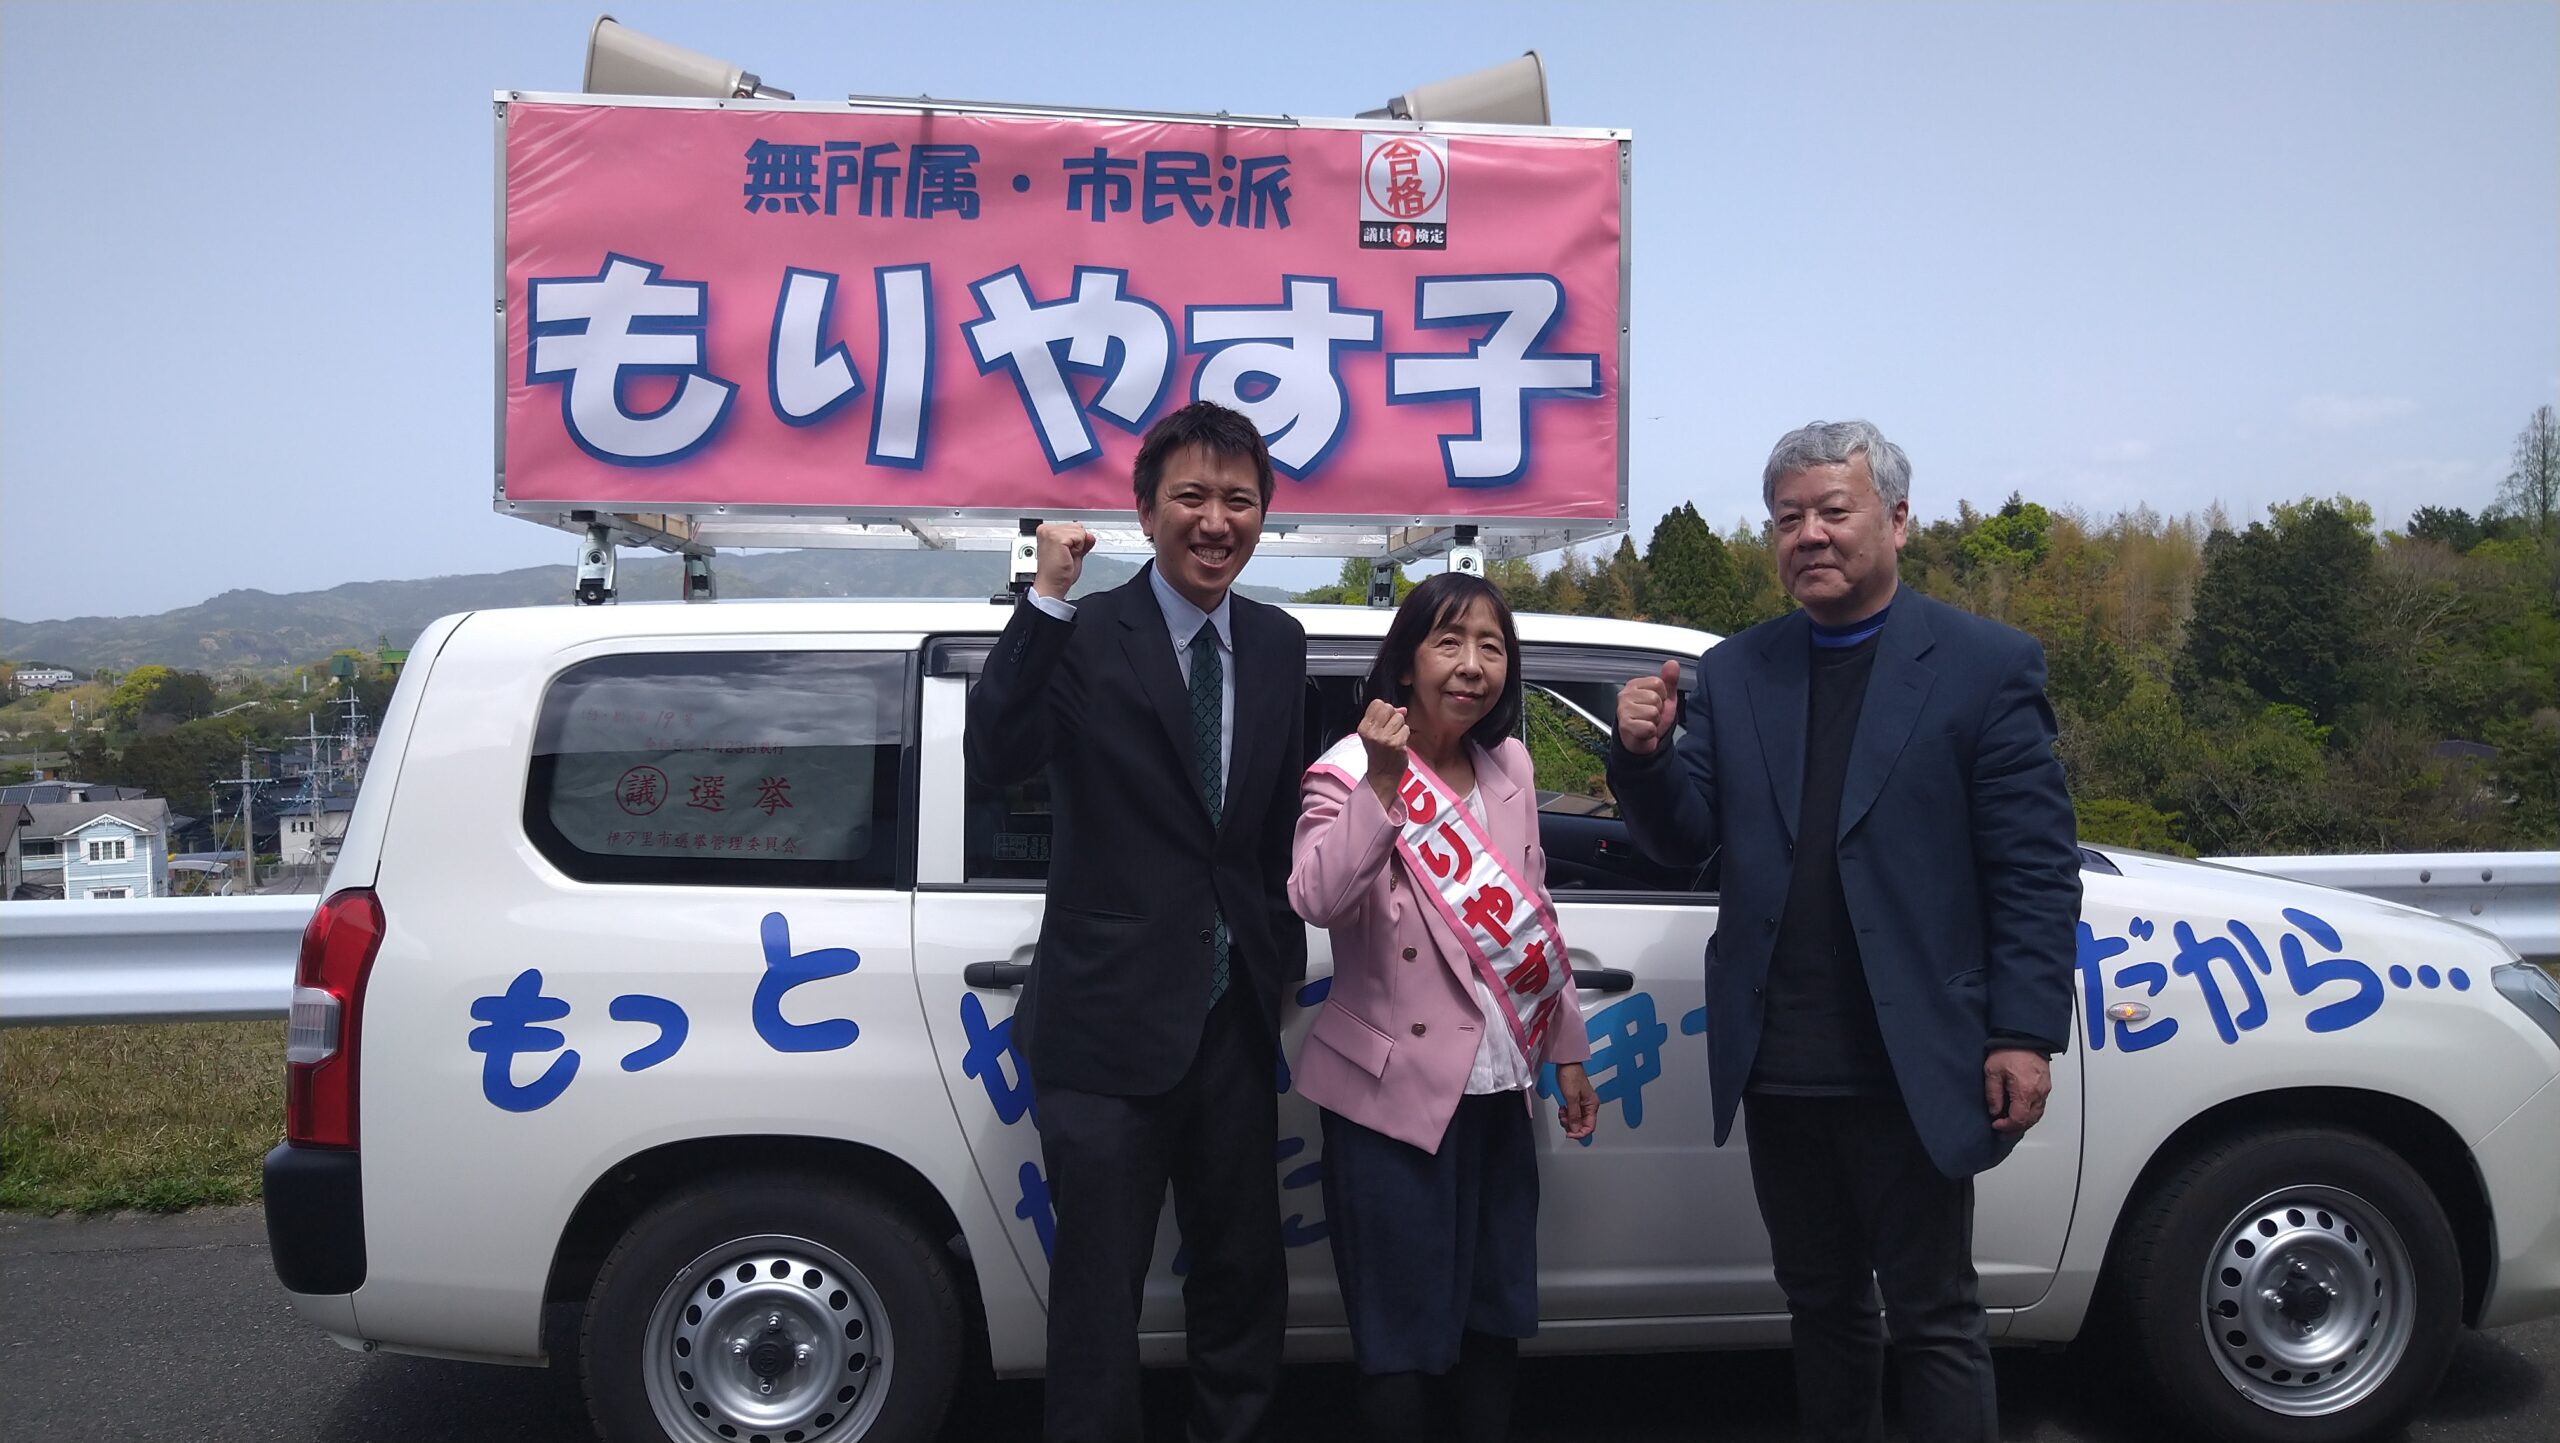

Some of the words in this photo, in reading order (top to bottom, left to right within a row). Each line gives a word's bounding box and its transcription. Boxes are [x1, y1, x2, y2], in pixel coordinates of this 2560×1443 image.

[742, 138, 1293, 231] 無所属・市民派
[1383, 140, 1427, 217] 合格
[1363, 226, 1444, 246] 議員力検定
[526, 250, 1600, 488] もりやす子
[607, 831, 796, 853] 伊万里市選挙管理委員会
[468, 912, 860, 1112] もっと
